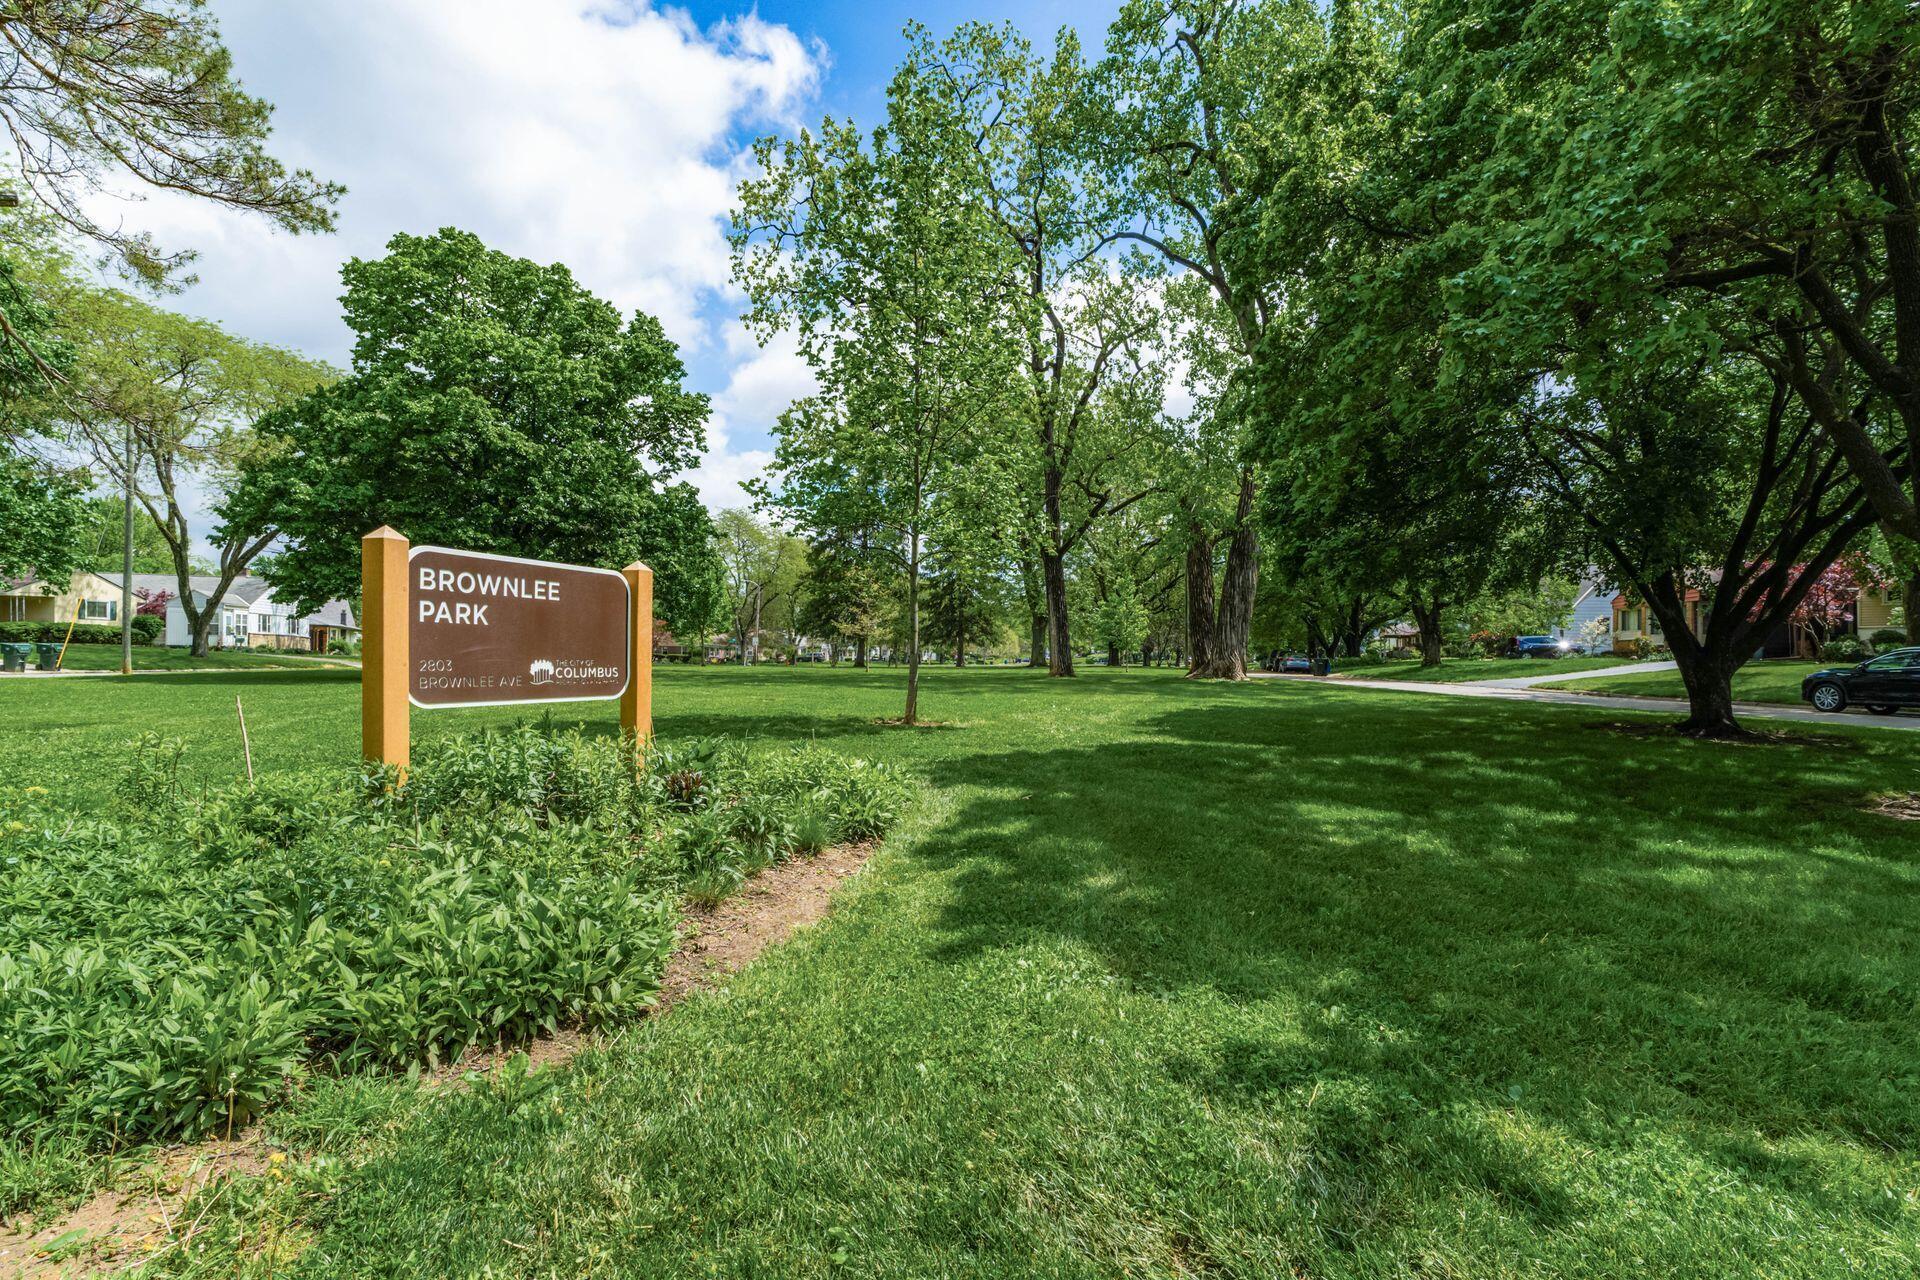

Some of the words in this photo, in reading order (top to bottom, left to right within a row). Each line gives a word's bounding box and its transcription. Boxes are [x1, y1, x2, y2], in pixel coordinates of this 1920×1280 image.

[419, 567, 560, 602] BROWNLEE
[419, 600, 489, 626] PARK
[419, 659, 453, 672] 2803
[556, 659, 568, 667] THE
[569, 659, 584, 667] CITY
[586, 659, 594, 667] OF
[555, 667, 619, 678] COLUMBUS
[419, 676, 494, 689] BROWNLEE
[499, 675, 522, 687] AVE
